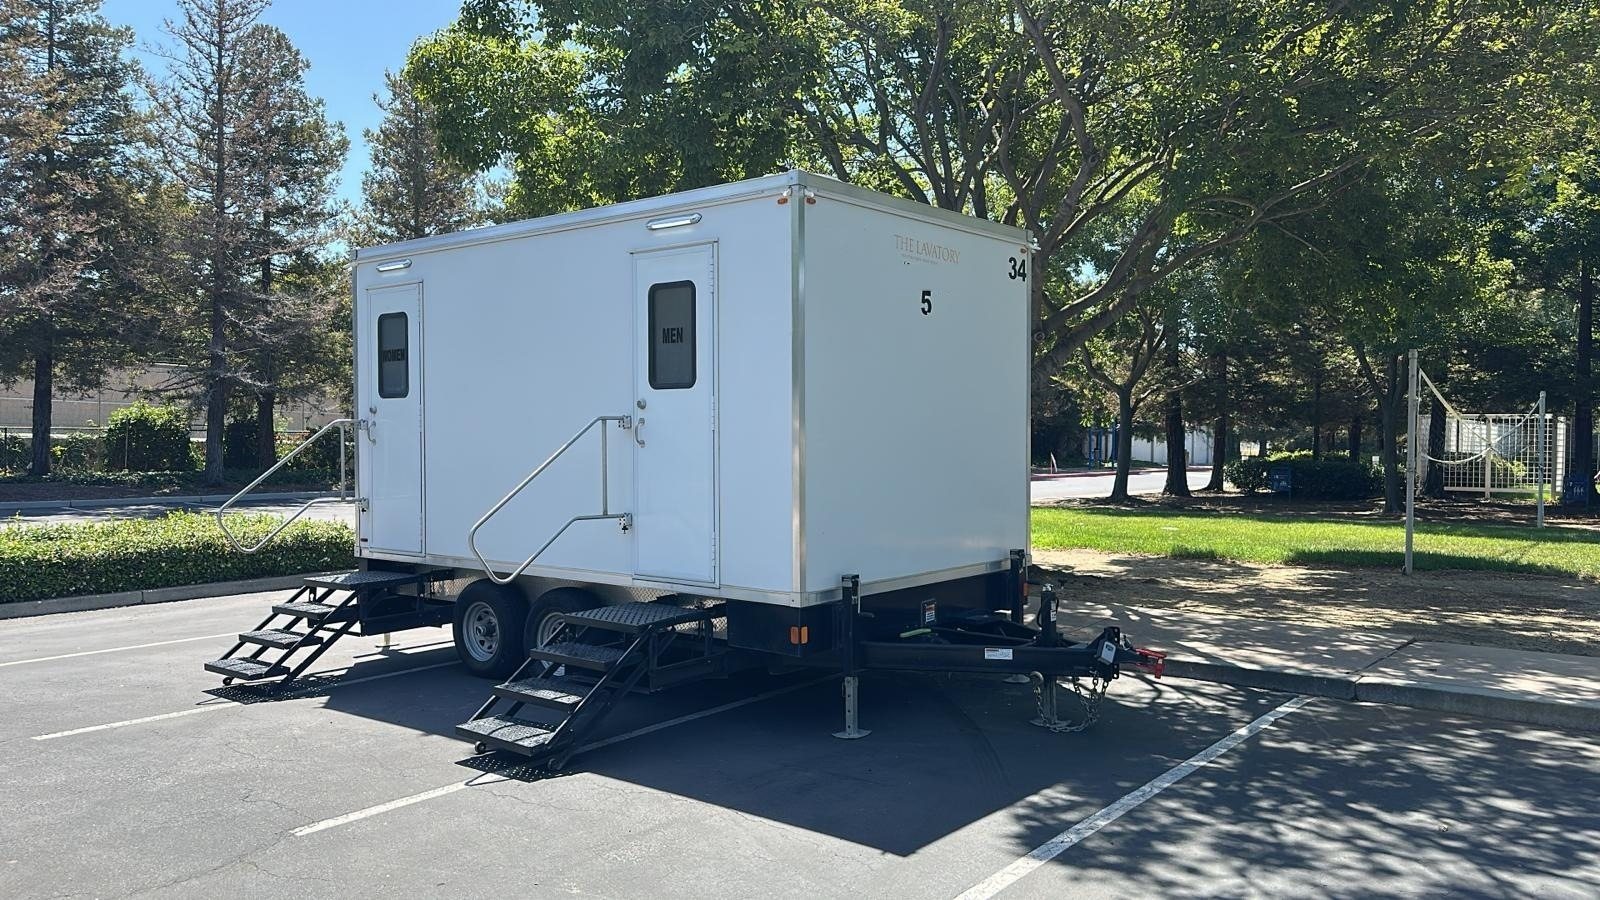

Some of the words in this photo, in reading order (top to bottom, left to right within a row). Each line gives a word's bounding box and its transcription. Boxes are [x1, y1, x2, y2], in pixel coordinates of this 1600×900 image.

[894, 234, 914, 253] THE
[916, 239, 961, 265] LAVATORY
[1008, 256, 1027, 282] 34
[921, 290, 932, 316] 5
[662, 327, 684, 345] MEN
[382, 348, 406, 362] WOMEN
